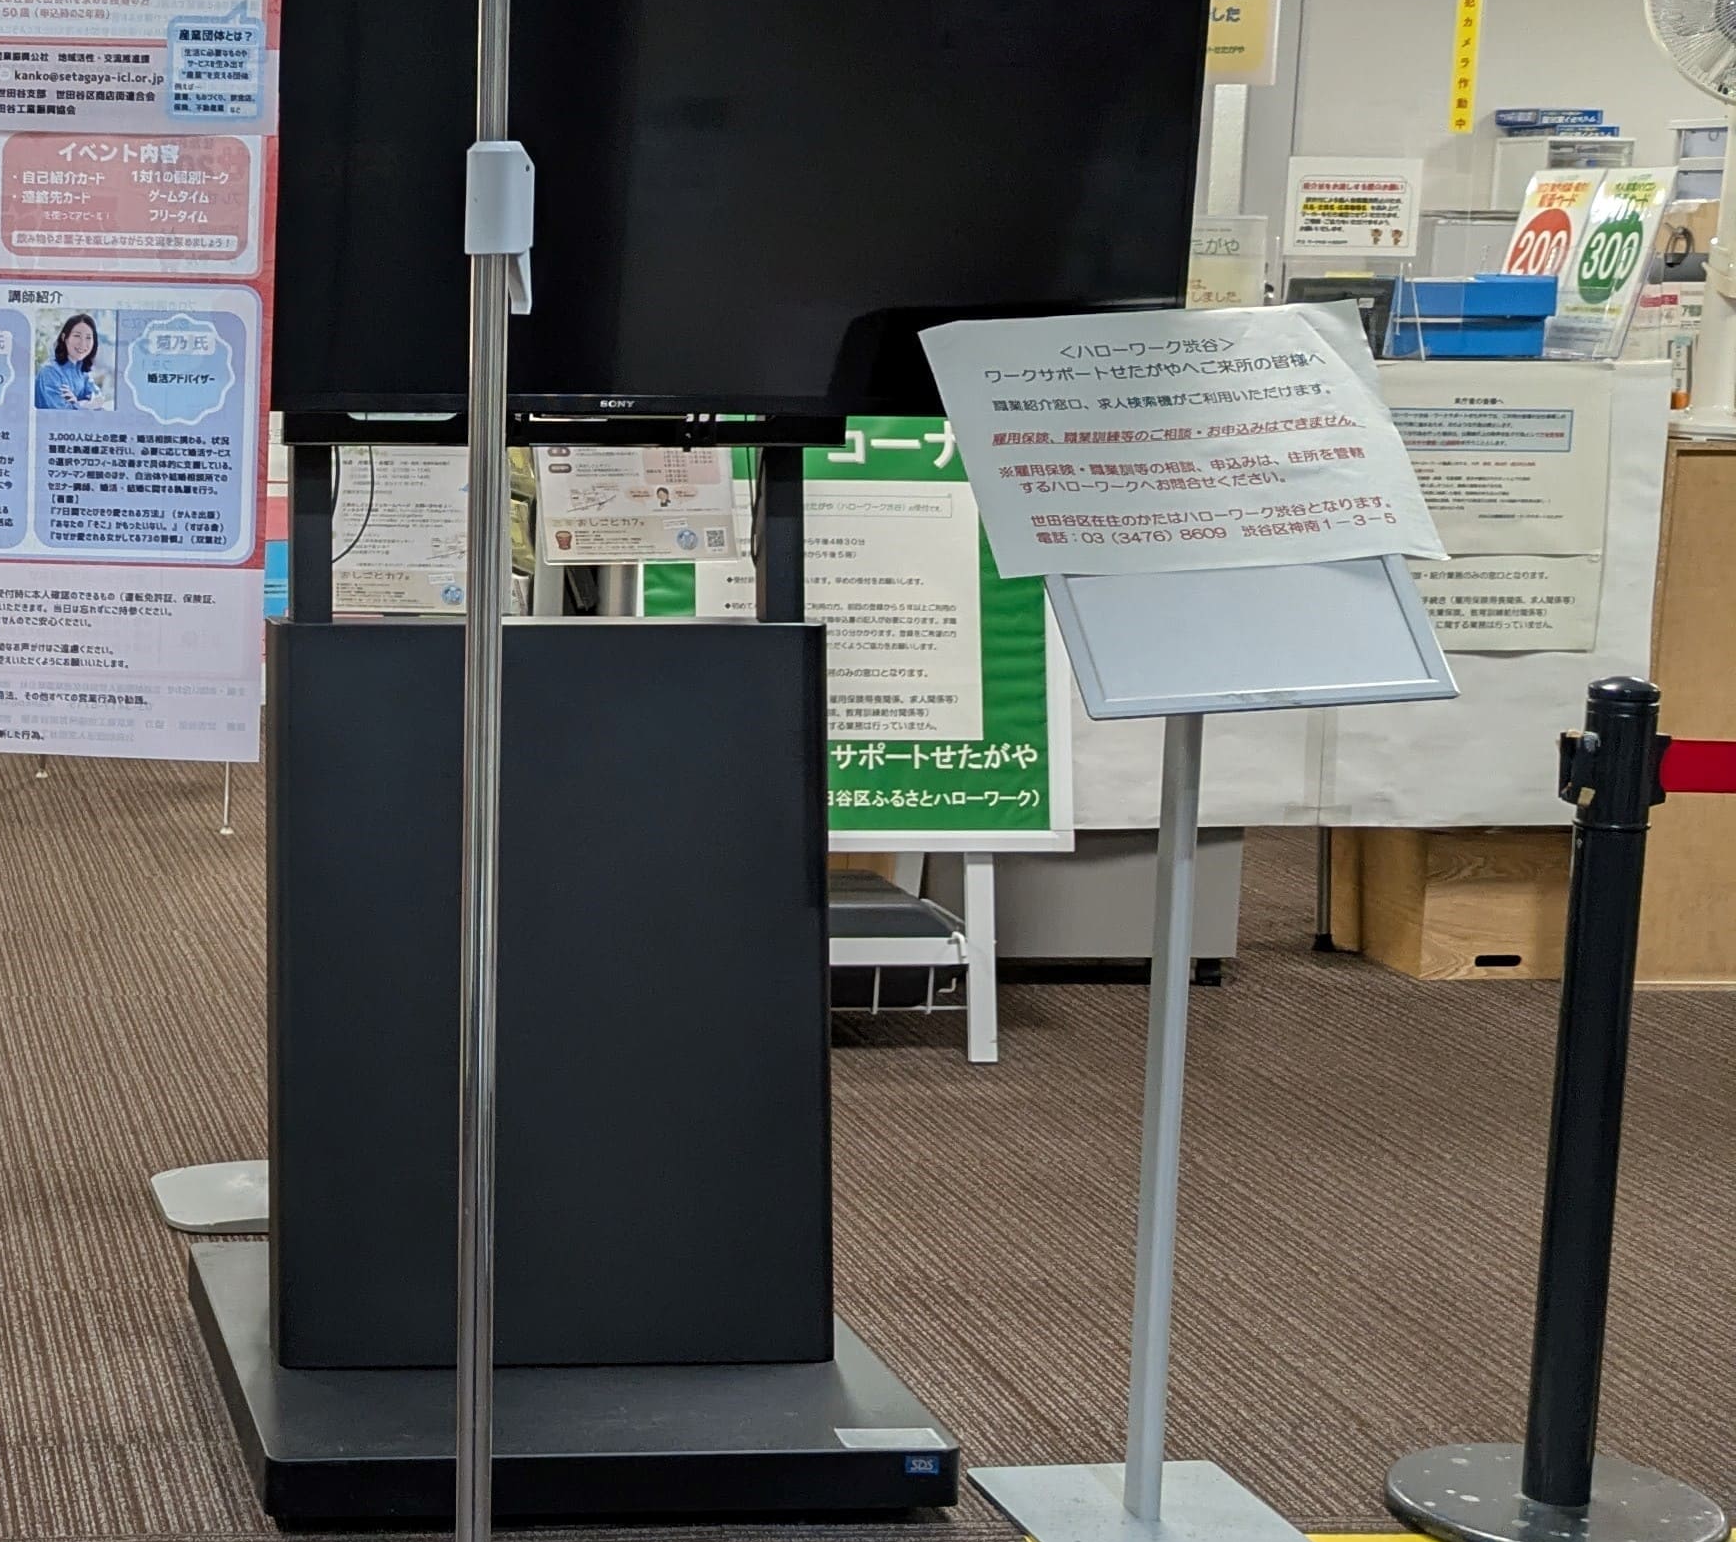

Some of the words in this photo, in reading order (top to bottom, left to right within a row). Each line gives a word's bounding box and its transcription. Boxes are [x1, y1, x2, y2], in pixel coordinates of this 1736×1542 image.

[179, 29, 252, 41] 産業団体とは？
[14, 71, 164, 85] kanko@setagaya-icl.or.jp
[58, 142, 180, 164] イベント内容
[149, 190, 209, 203] ゲームタイム
[149, 209, 208, 223] フリータイム
[1511, 230, 1568, 275] 200
[1581, 232, 1639, 280] 300
[8, 290, 63, 304] 講師紹介
[985, 352, 1326, 383] ワークサポートせたがやへご来所の皆様へ
[147, 373, 215, 385] 婚活アドバイザー
[600, 400, 635, 408] SONY
[992, 383, 1331, 411] 職業紹介窓口、求人検索機がご利用いただけます。
[992, 415, 1358, 445] 雇用保険、職業訓練等のご相談・お申込みはできません。
[1020, 472, 1286, 493] するハローワークへお問合せください。
[1031, 496, 1391, 527] 世田谷区在住のかたはハローワーク渋谷となります。
[831, 742, 1038, 770] サポートせたがや
